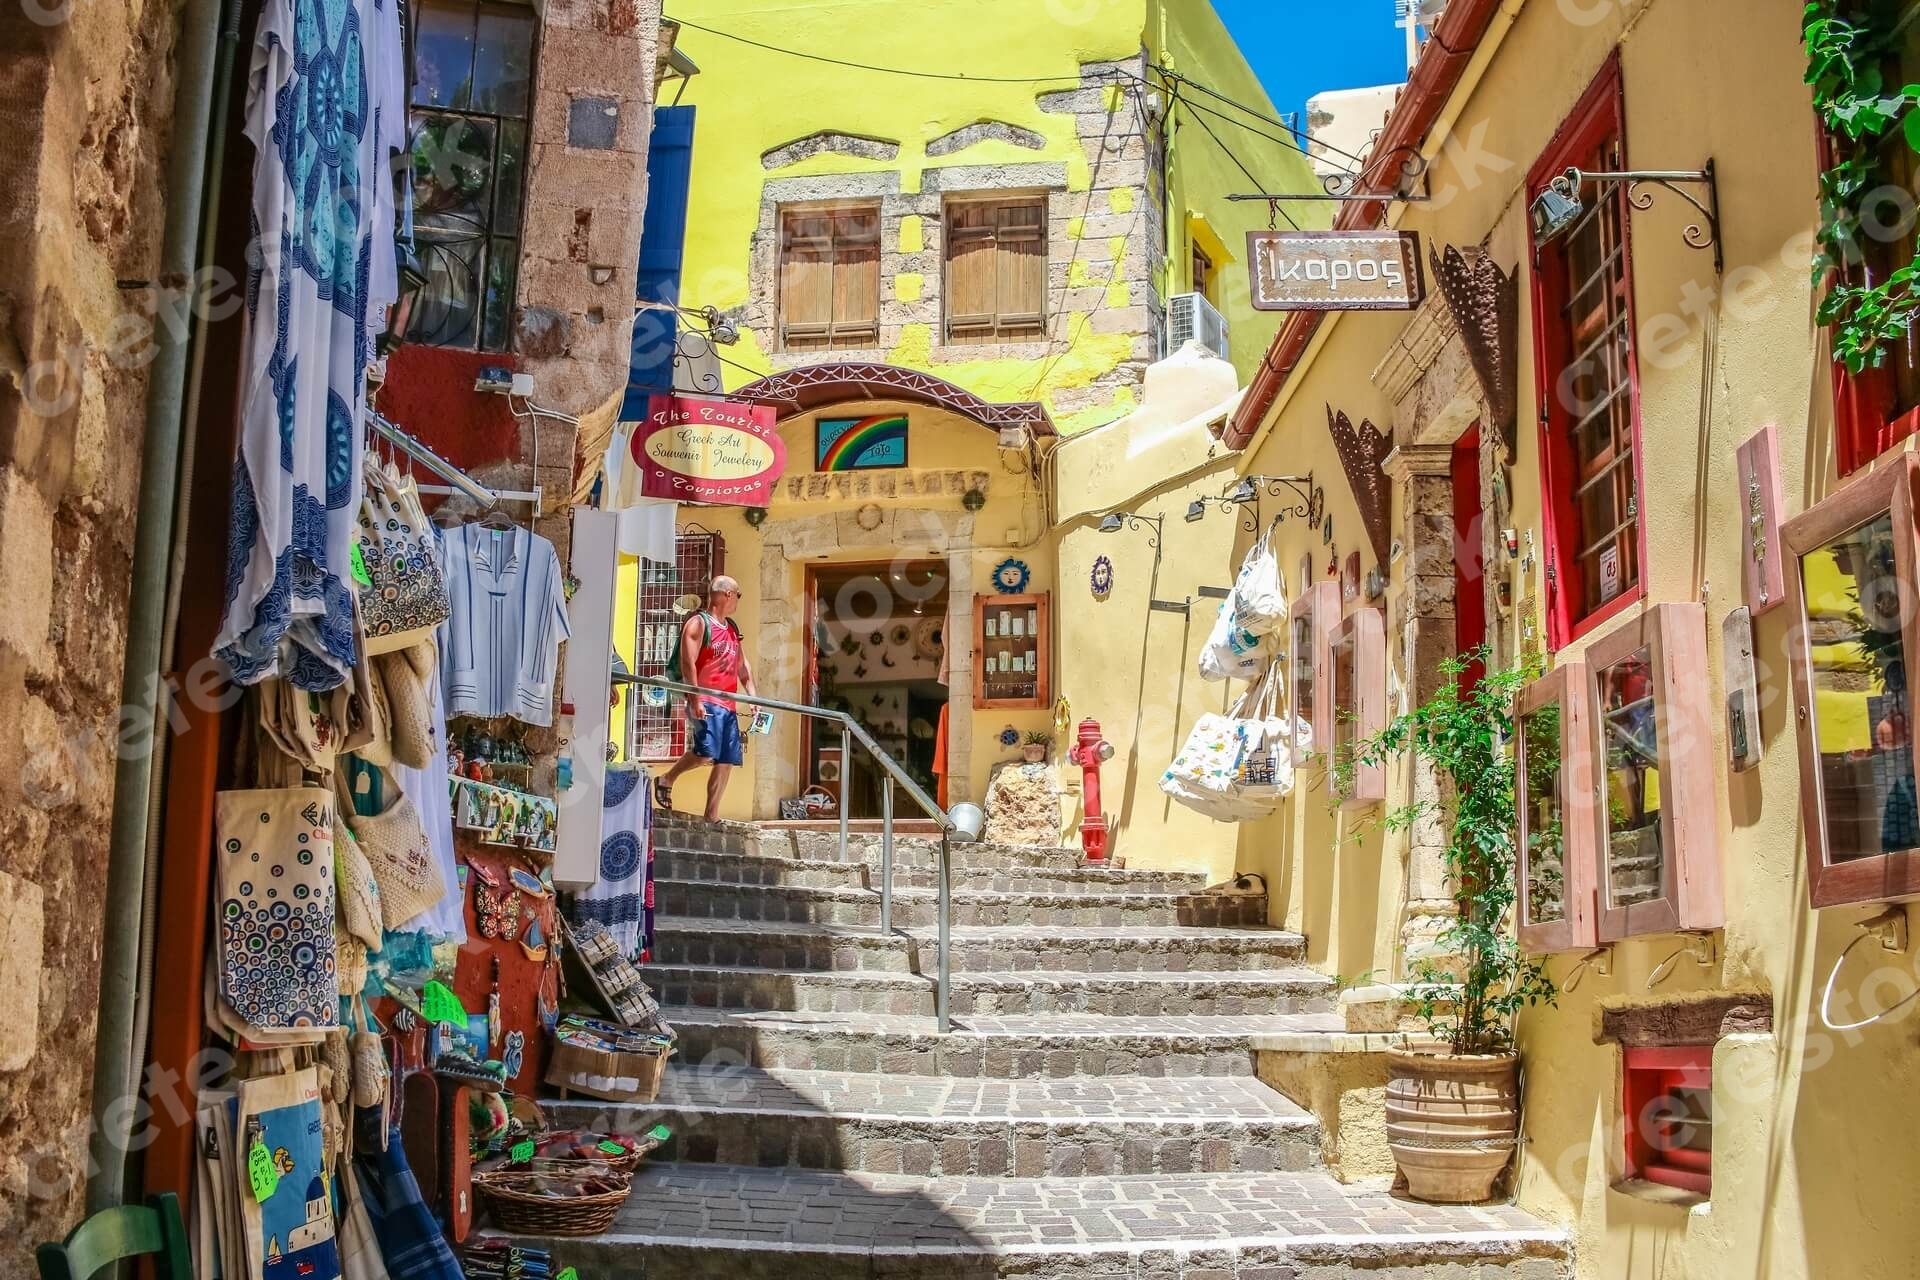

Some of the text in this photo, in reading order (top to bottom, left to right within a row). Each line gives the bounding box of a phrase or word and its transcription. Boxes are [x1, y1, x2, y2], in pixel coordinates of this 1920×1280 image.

[653, 407, 771, 438] The Tourist
[677, 428, 742, 448] Greek Art
[652, 442, 764, 471] Souvenir Jewelery
